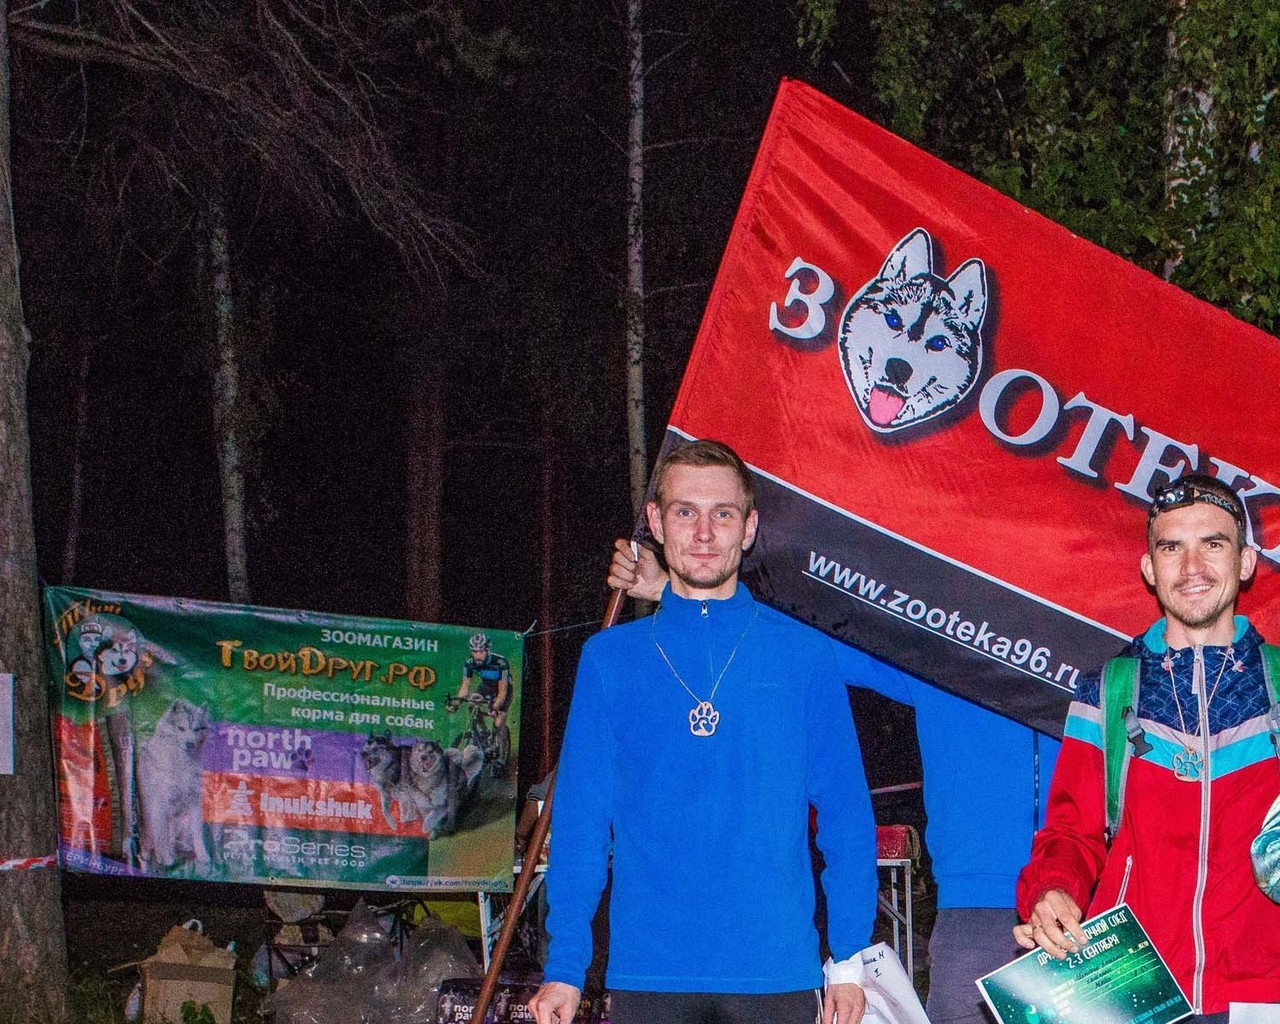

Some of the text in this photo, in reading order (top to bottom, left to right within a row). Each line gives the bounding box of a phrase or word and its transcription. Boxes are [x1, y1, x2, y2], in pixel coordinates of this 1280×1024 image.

[808, 551, 1079, 690] www.zooteka96.ru
[321, 629, 439, 652] ЗООМАГАЗИН
[263, 683, 435, 710] Профессиональные
[291, 706, 435, 730] корма для собак
[226, 727, 312, 751] north
[232, 749, 293, 772] paw
[1066, 953, 1084, 969] 2-3
[1082, 933, 1120, 960] СЕНТЯБРЯ
[454, 1003, 474, 1013] nor
